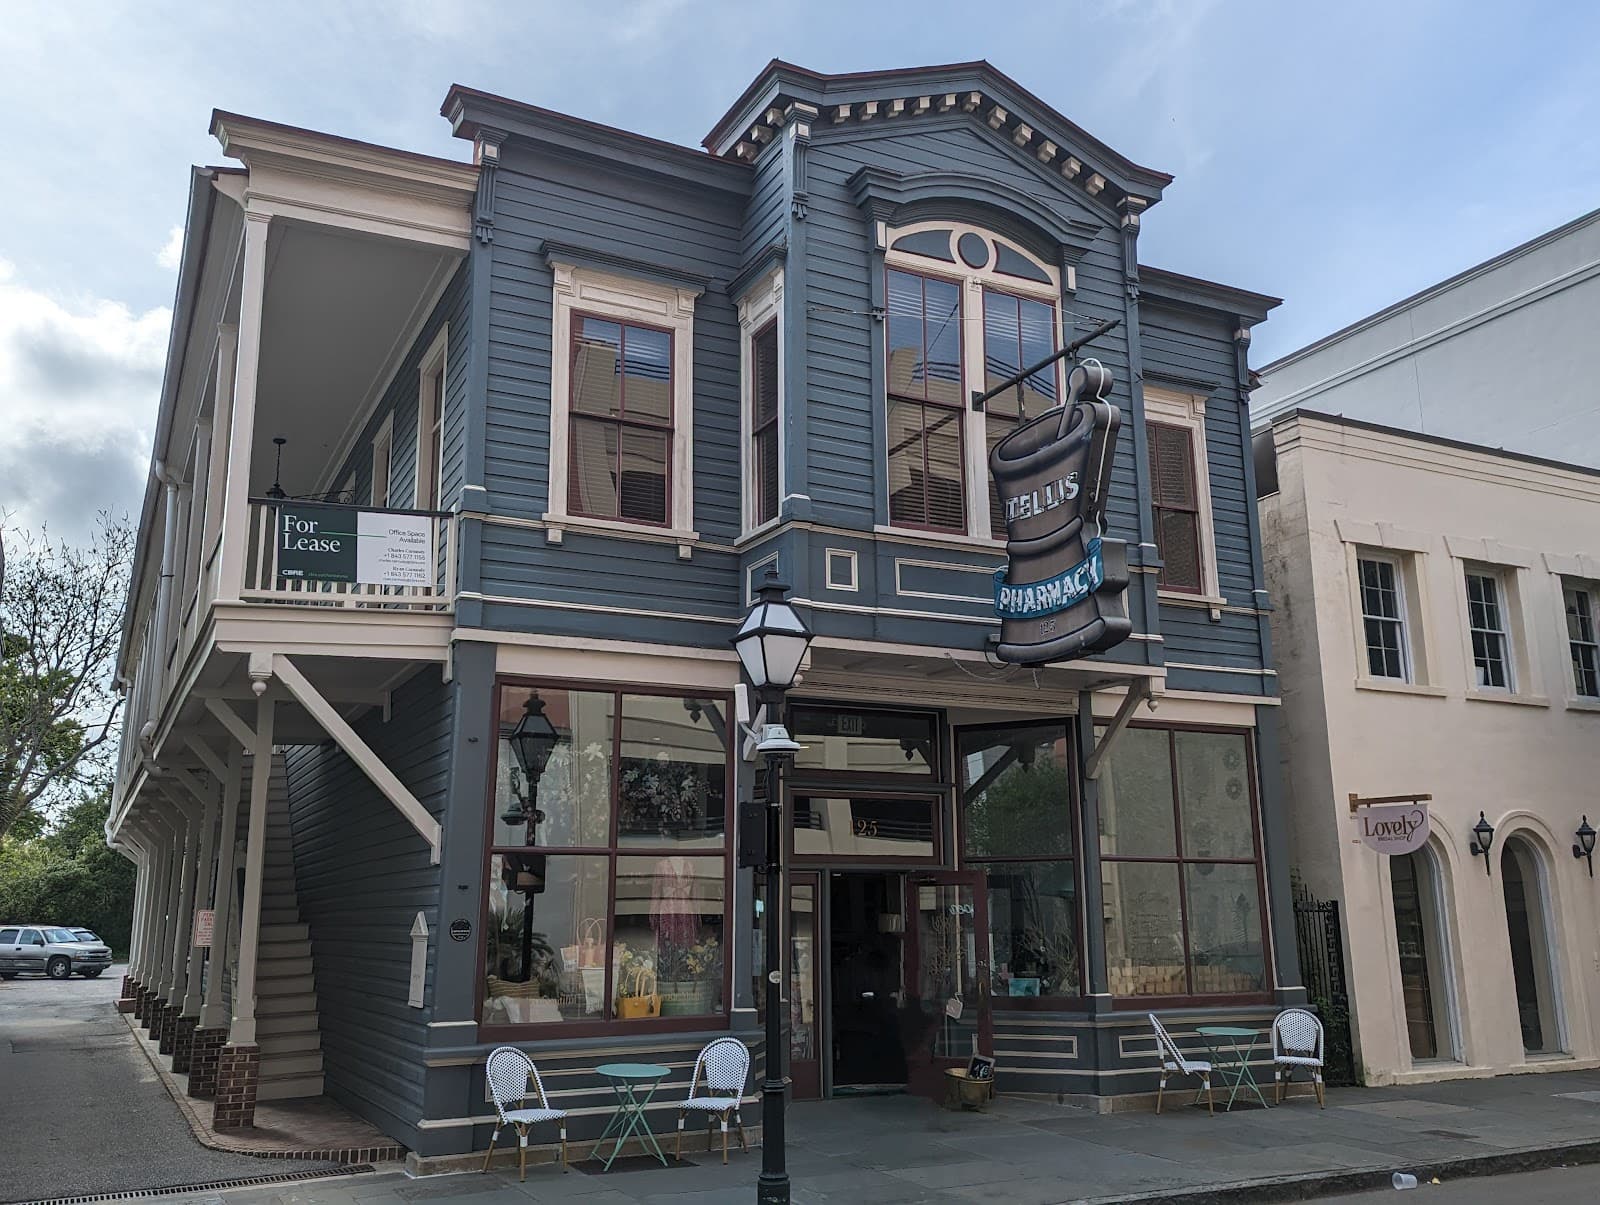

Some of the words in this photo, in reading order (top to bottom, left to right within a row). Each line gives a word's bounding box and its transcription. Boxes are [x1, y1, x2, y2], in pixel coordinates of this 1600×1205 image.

[1006, 471, 1080, 522] TELLIS
[283, 514, 319, 534] For
[388, 529, 406, 537] Office
[407, 530, 425, 538] Space
[283, 533, 341, 553] Lease
[400, 536, 425, 544] Available
[281, 569, 304, 577] CBRE
[999, 556, 1100, 613] PHARMACY
[1039, 619, 1057, 636] 125
[1363, 809, 1424, 842] Lovely
